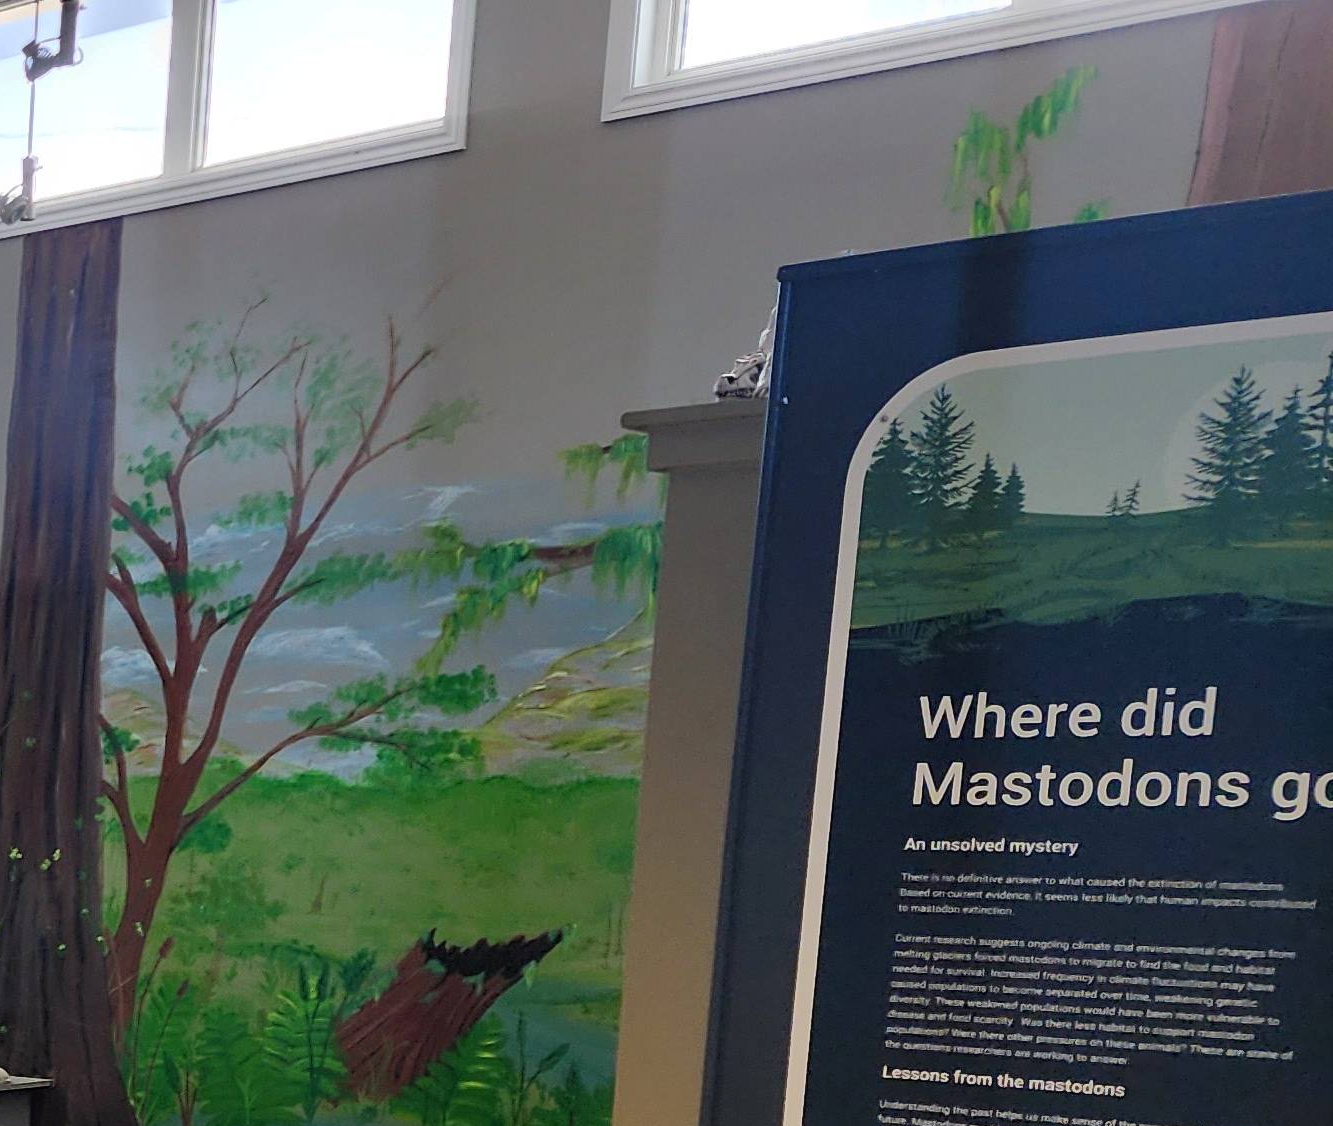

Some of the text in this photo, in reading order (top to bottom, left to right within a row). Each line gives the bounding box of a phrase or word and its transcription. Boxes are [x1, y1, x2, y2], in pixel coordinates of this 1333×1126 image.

[920, 687, 1217, 739] Where did
[912, 759, 1250, 807] Mastodons
[904, 838, 1079, 856] An unsolved mystery
[1045, 875, 1055, 884] to
[1059, 876, 1084, 885] what
[882, 1065, 1125, 1096] Lessons from the mastodons
